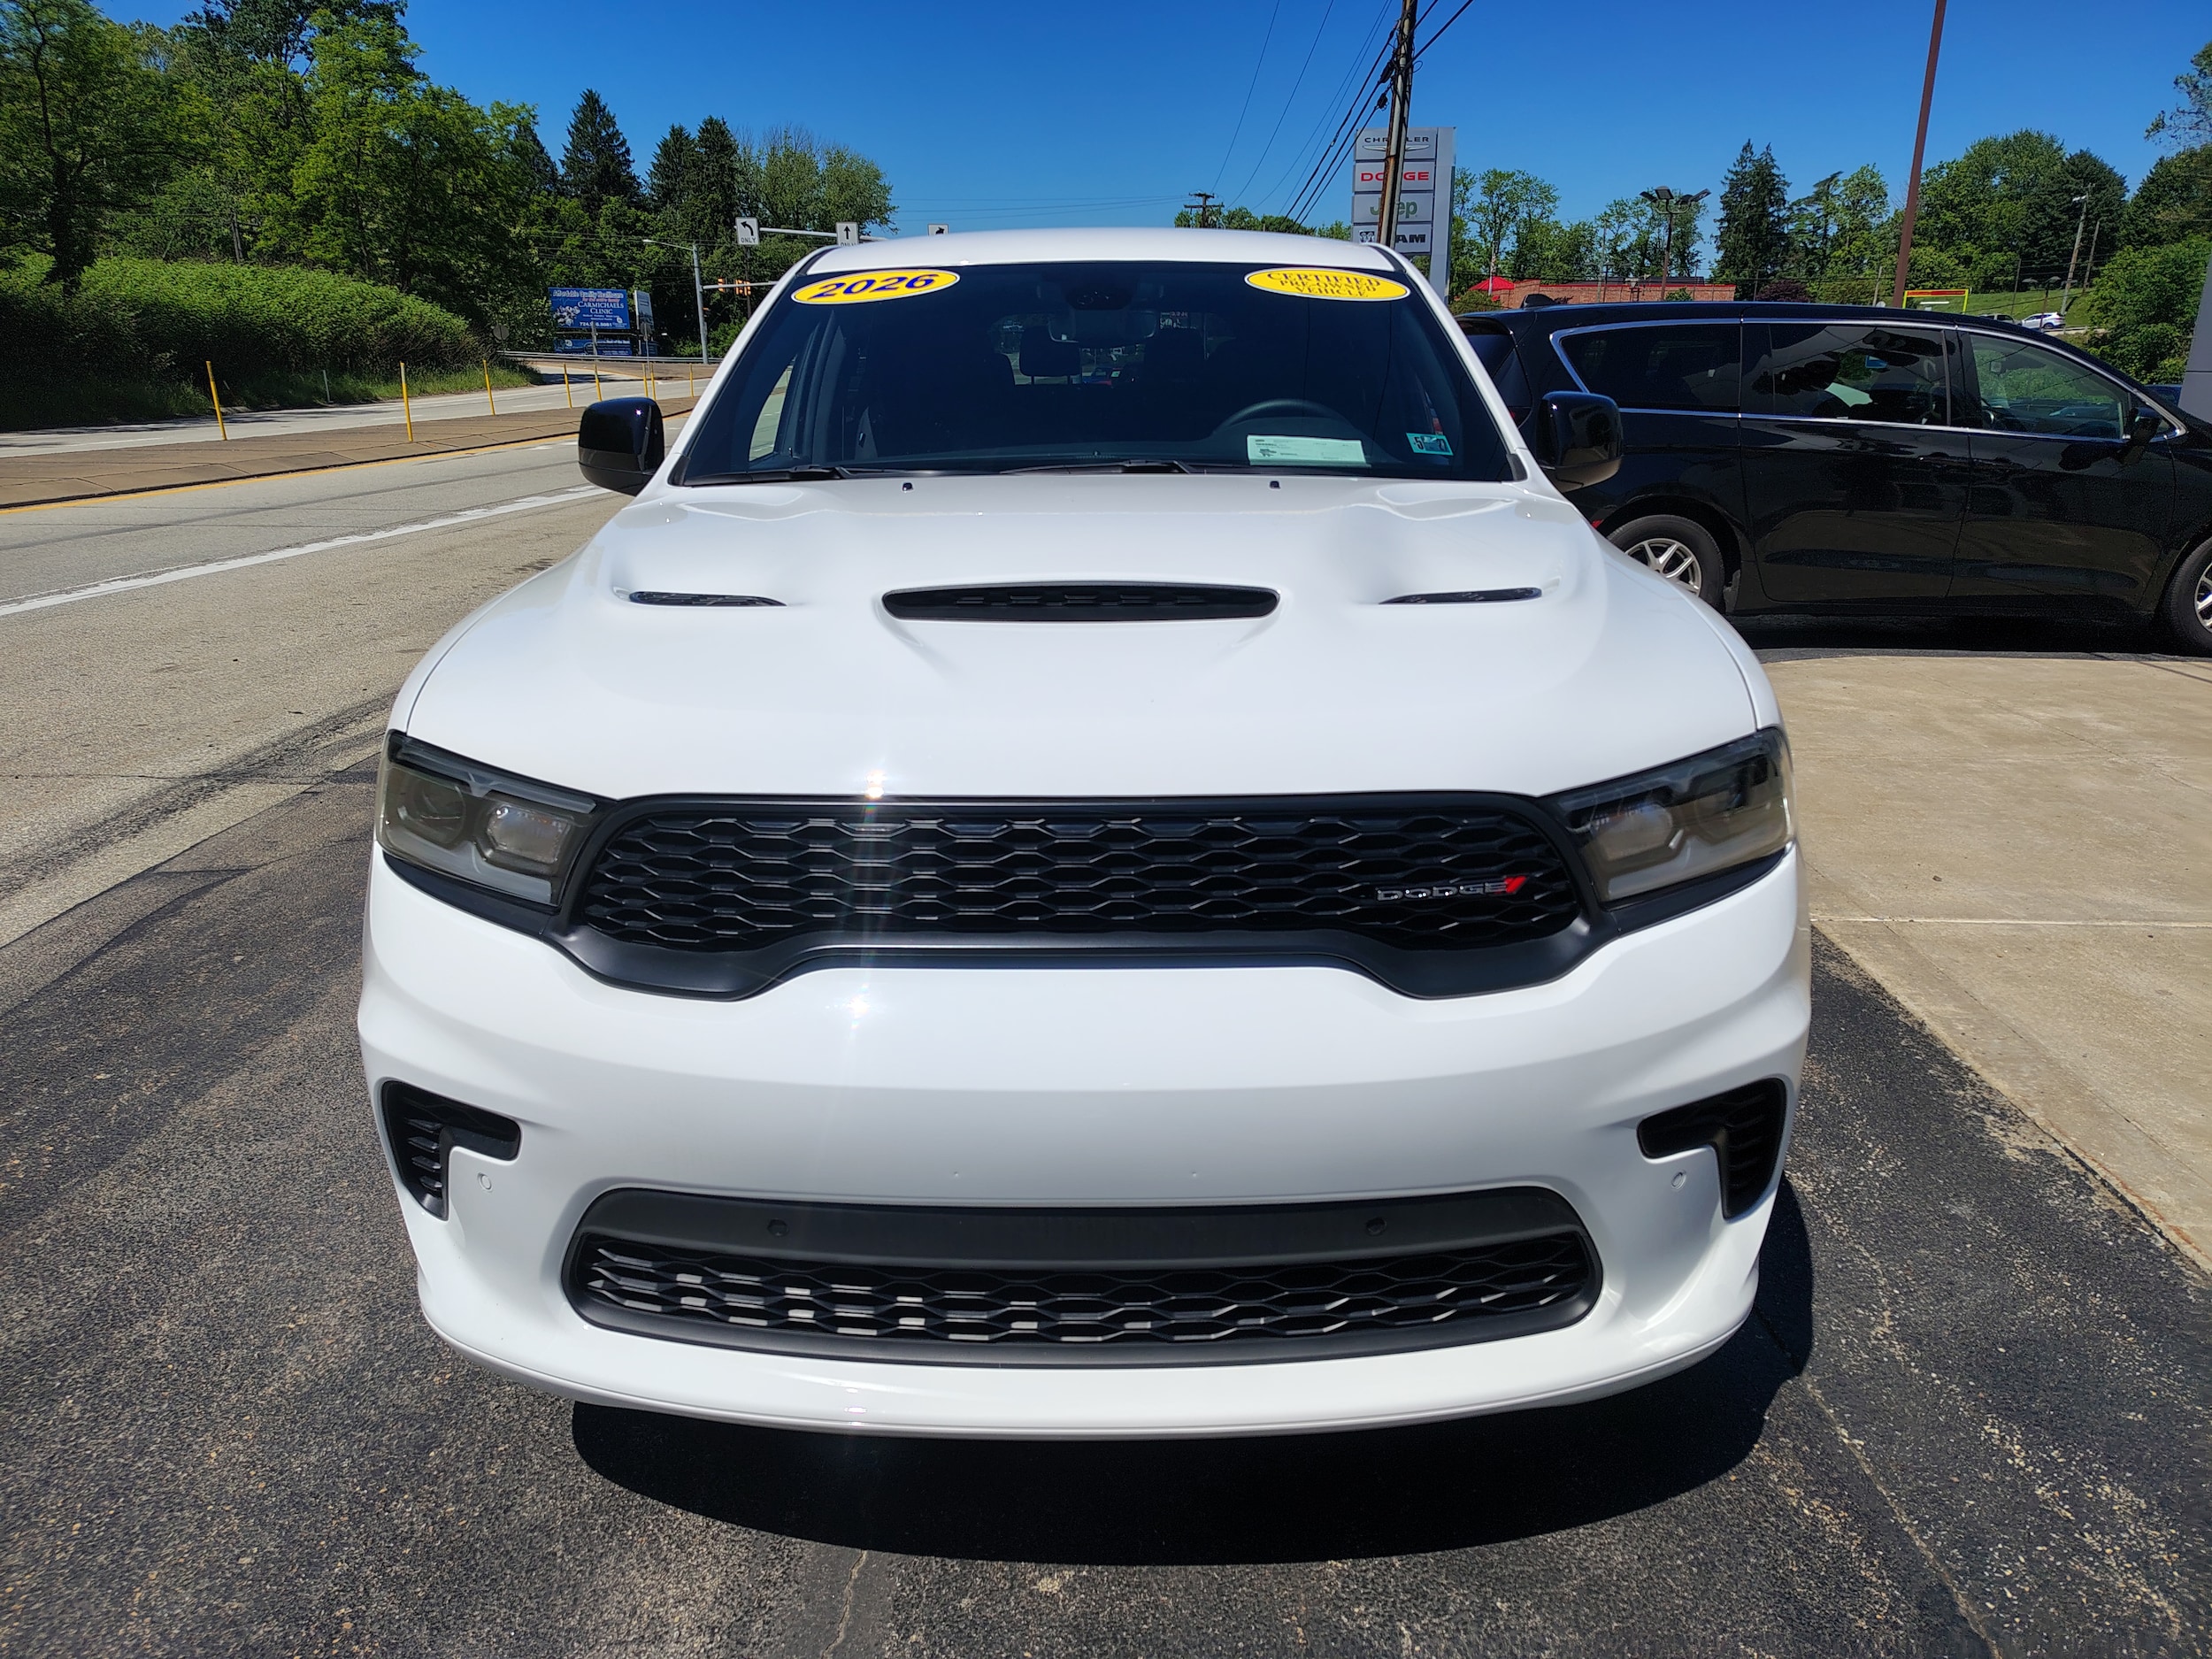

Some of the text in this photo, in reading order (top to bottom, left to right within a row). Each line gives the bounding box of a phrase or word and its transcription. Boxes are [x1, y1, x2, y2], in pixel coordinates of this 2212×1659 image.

[1361, 172, 1429, 181] DOGE
[1370, 197, 1417, 219] Jep
[1395, 234, 1426, 243] AM
[807, 273, 939, 301] 2026
[1267, 273, 1381, 287] CERTIFIED
[1296, 286, 1369, 297] VEHICLE
[1377, 881, 1507, 901] DODGE
